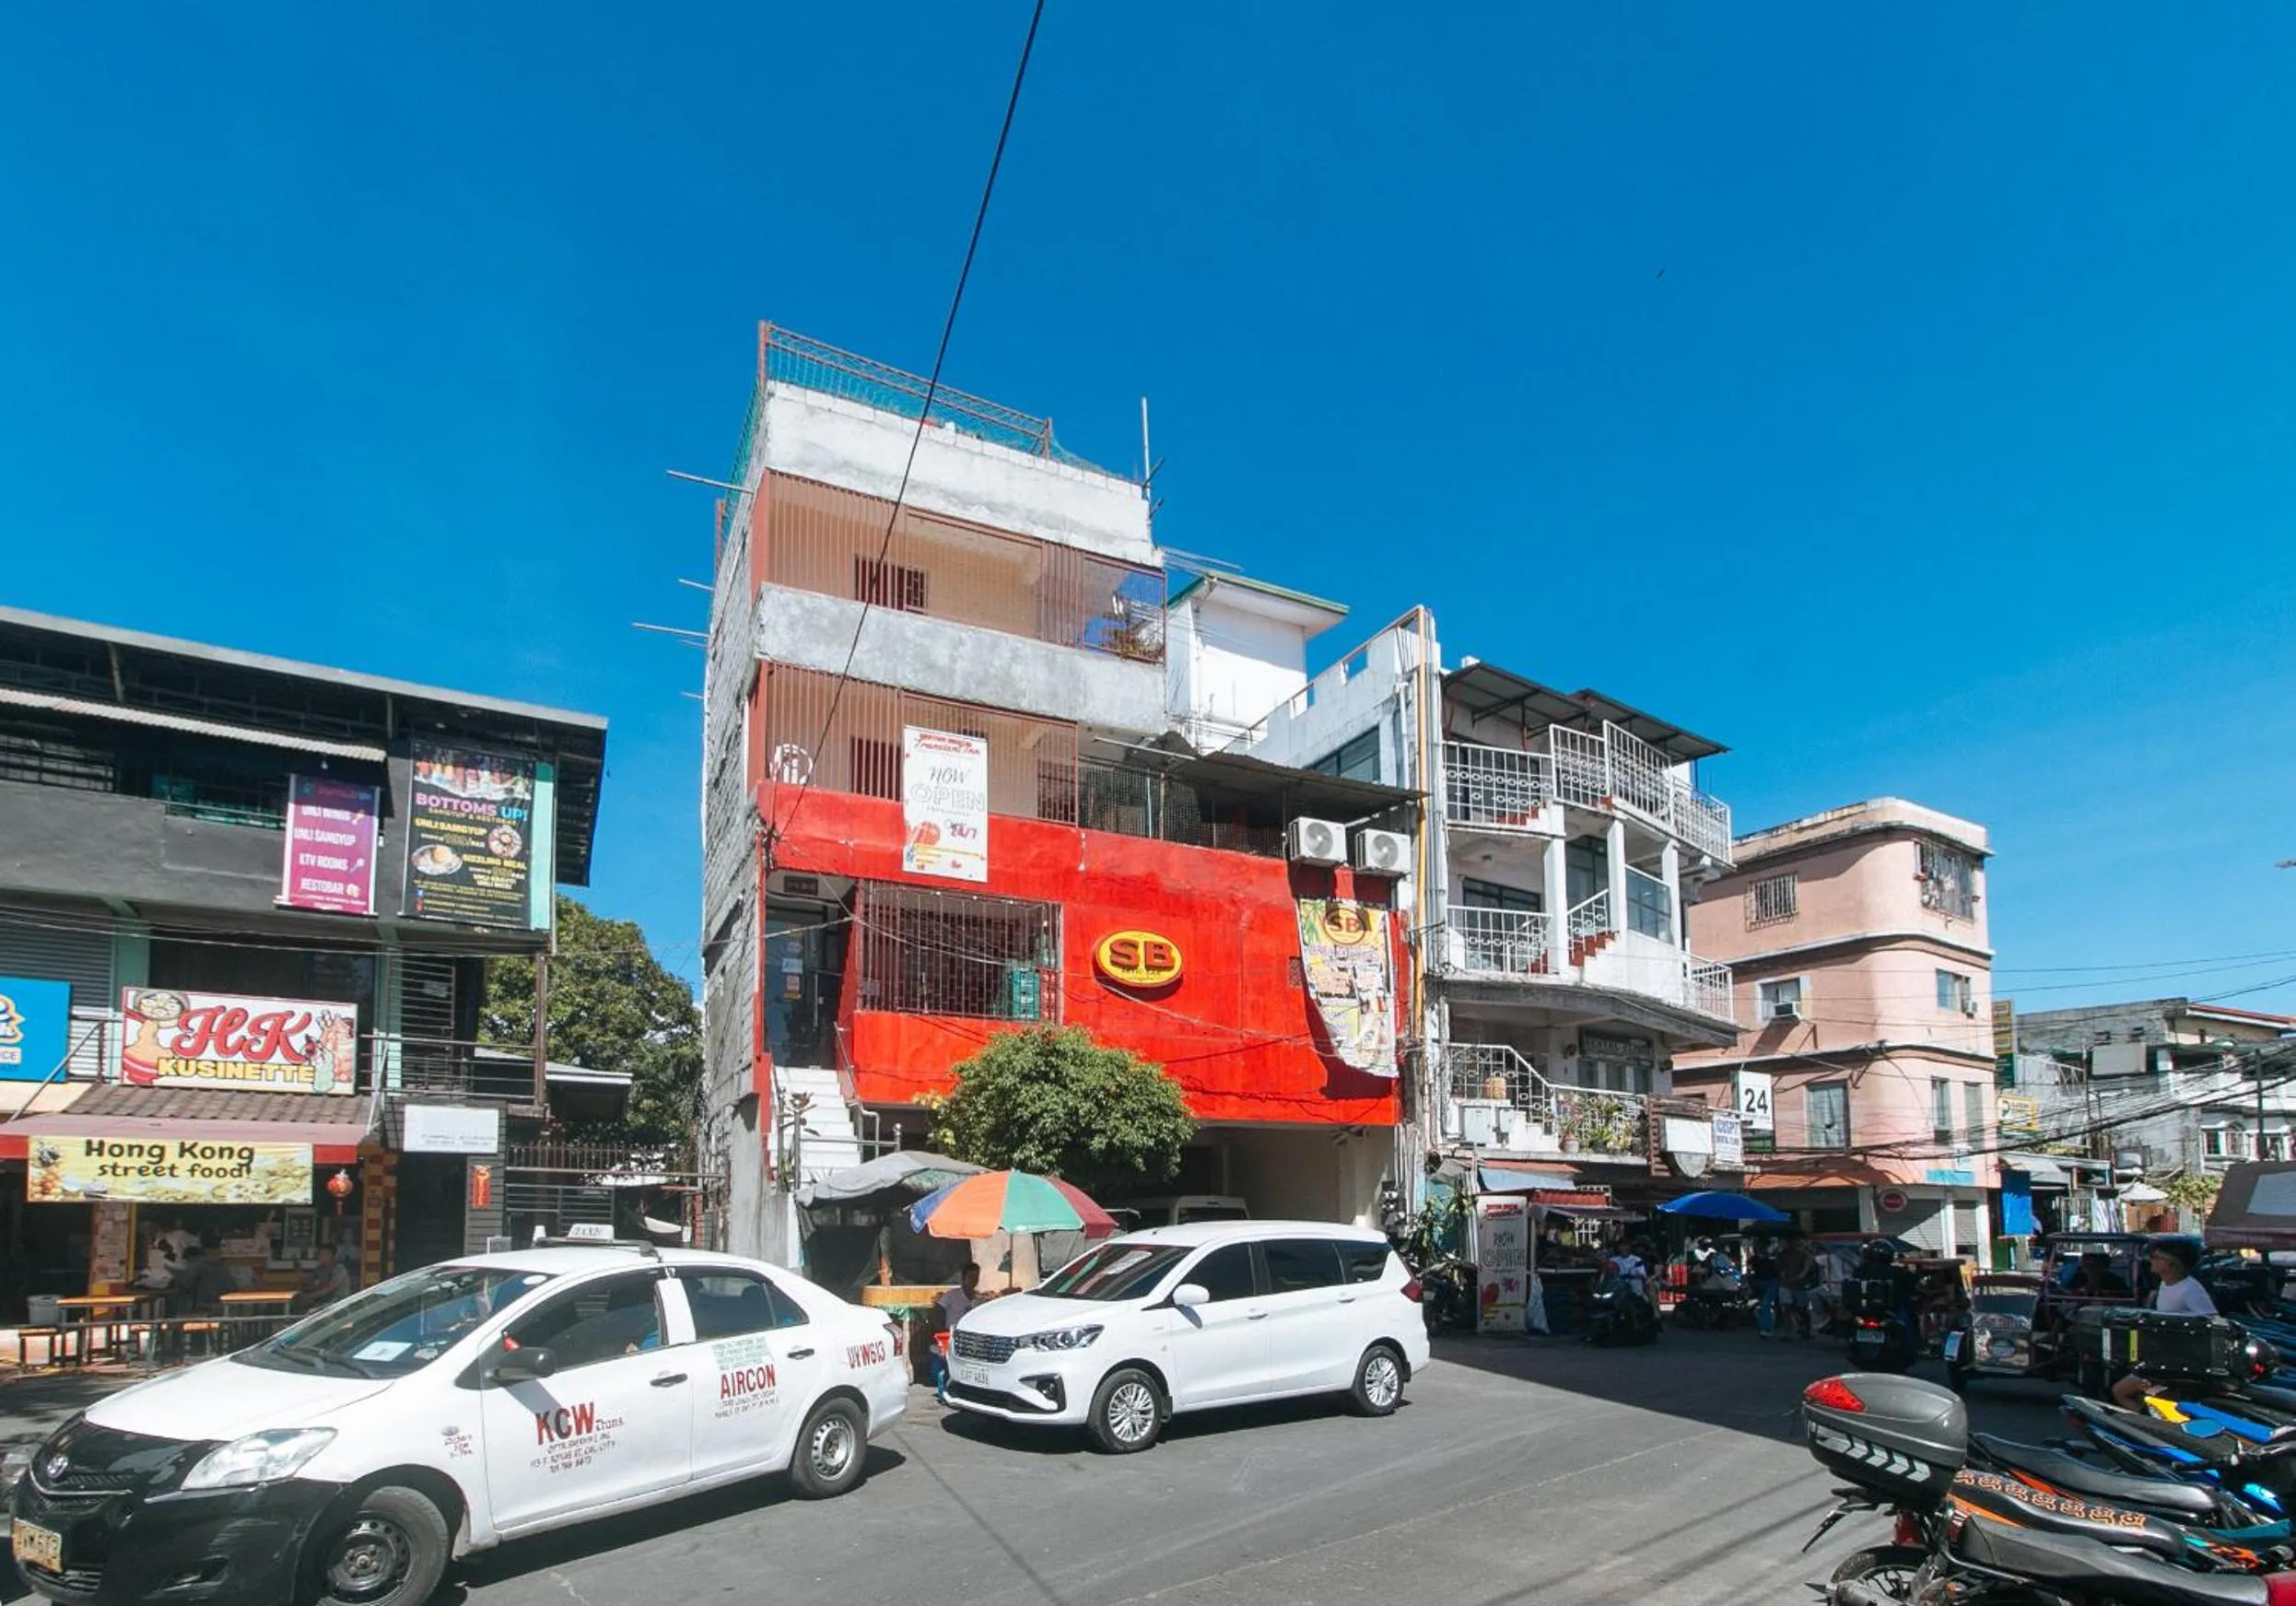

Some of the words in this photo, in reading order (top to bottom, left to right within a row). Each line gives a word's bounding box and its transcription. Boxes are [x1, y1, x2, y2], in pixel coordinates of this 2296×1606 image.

[929, 767, 971, 784] NOW
[416, 792, 497, 816] BOTTOMS
[500, 806, 528, 822] UP!
[911, 783, 985, 812] OPEN
[294, 827, 313, 840] UNLI
[314, 830, 357, 846] SAMGYUP
[299, 852, 316, 865] KTV
[317, 856, 348, 871] ROOMS
[299, 877, 345, 896] RESTOBAR
[1109, 938, 1176, 971] SB
[170, 1004, 313, 1064] HK
[158, 1057, 316, 1084] KUSINETTE
[1744, 1087, 1769, 1114] 24
[84, 1139, 167, 1166] Hong
[178, 1141, 256, 1168] Kong
[97, 1162, 180, 1178] street
[720, 1364, 777, 1400] AIRCON
[534, 1401, 595, 1446] KCW
